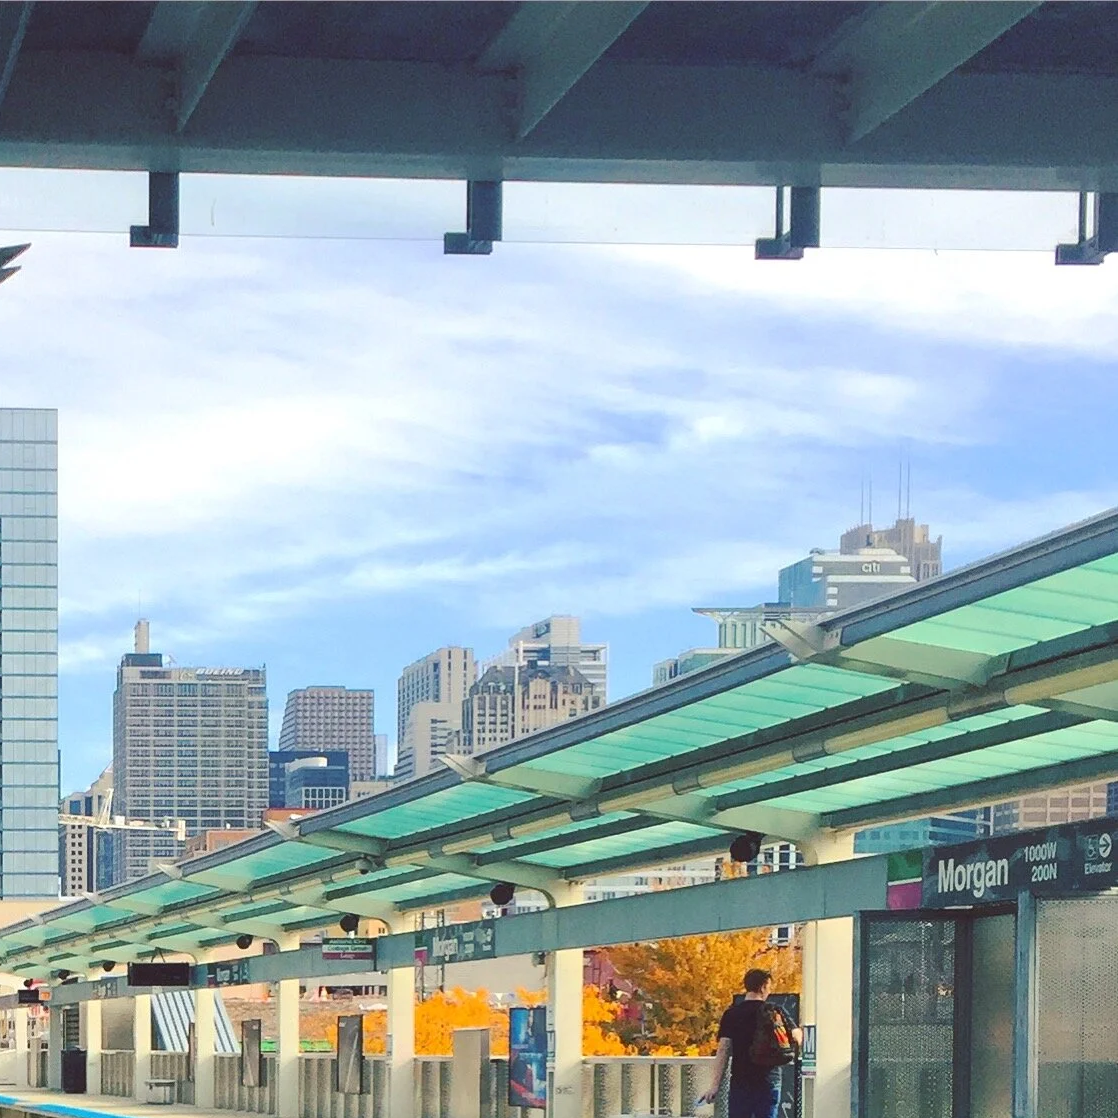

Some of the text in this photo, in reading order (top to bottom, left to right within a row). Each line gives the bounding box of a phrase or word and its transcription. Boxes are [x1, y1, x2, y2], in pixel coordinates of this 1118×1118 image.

[862, 561, 881, 574] citi
[1024, 841, 1057, 863] 1000W
[938, 857, 1009, 898] Morgan
[1031, 862, 1058, 883] 200N
[1084, 861, 1113, 876] Elevator
